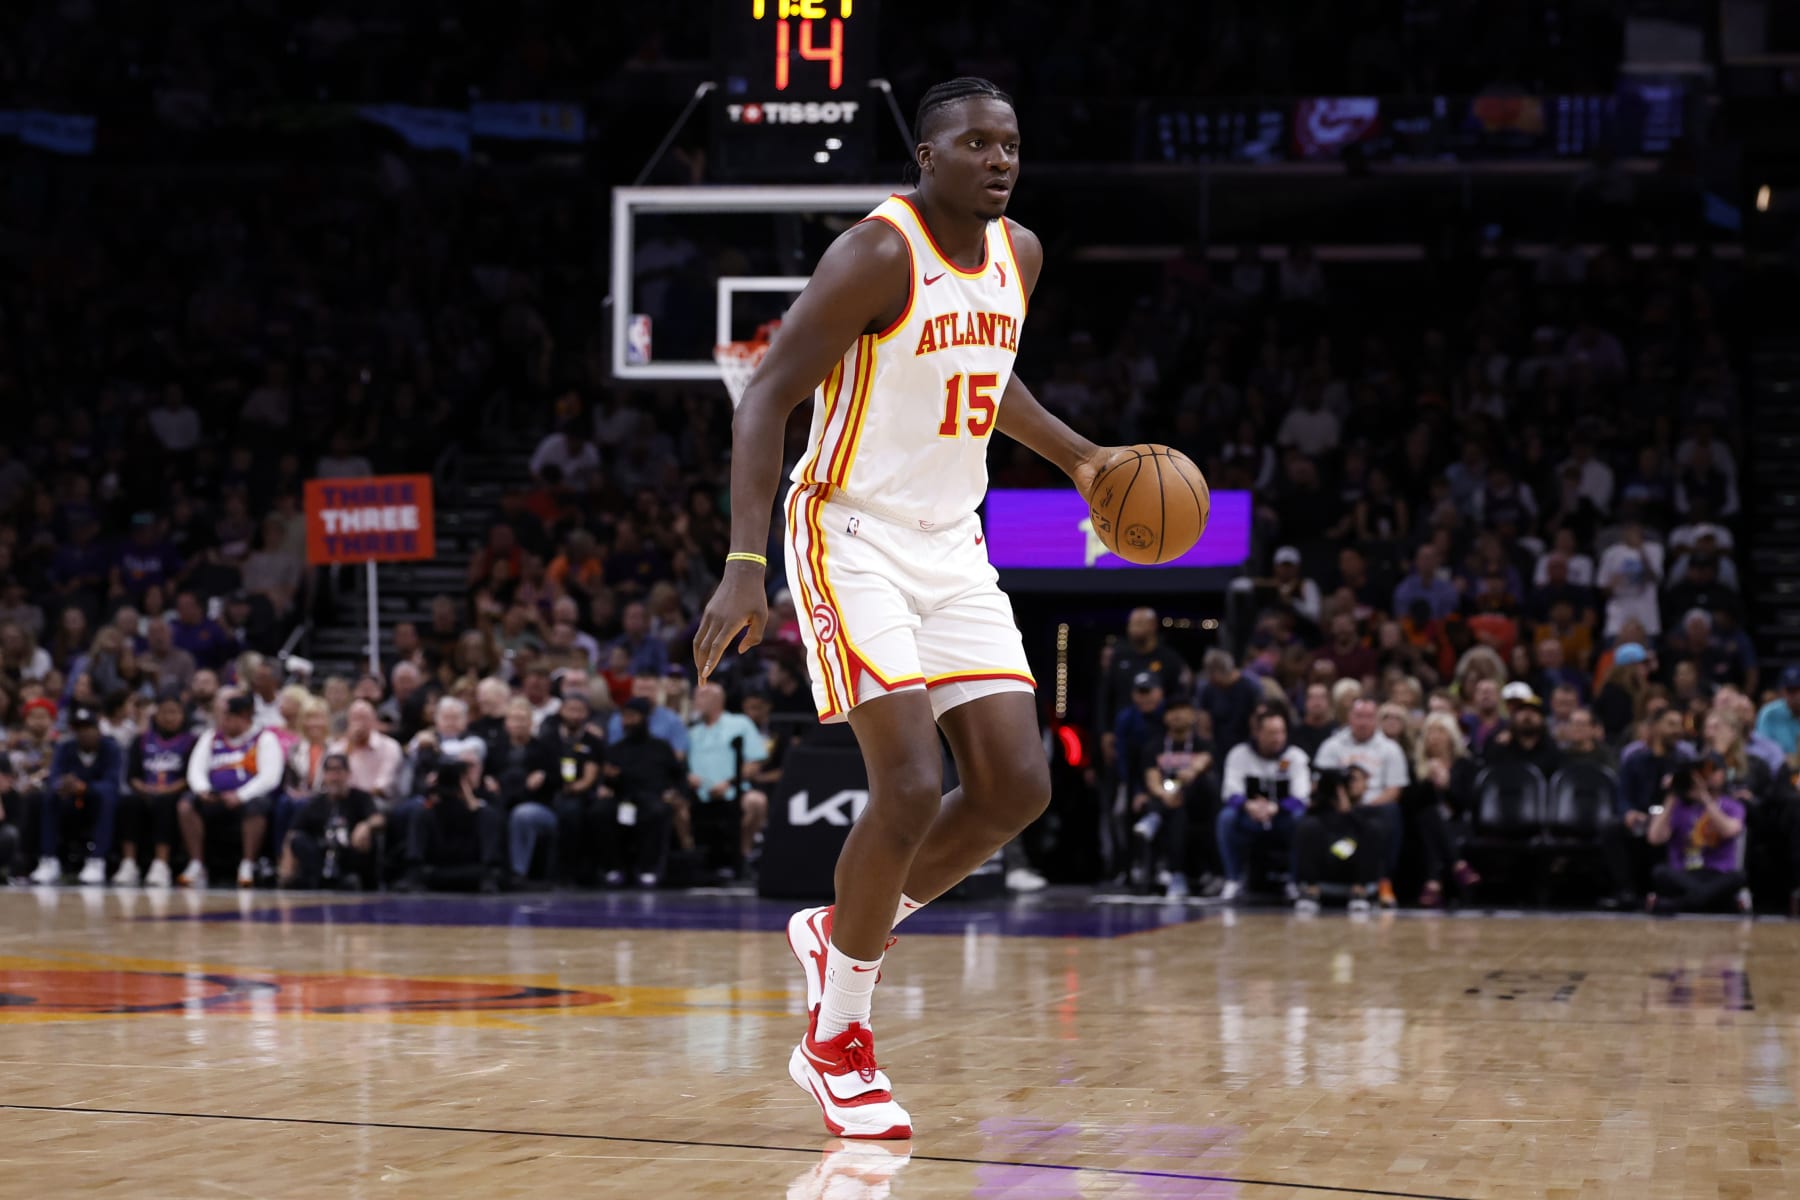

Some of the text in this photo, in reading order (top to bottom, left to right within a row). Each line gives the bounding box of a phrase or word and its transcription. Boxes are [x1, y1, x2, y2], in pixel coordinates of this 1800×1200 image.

[774, 17, 844, 91] 14
[763, 102, 858, 124] TISSOT
[915, 310, 1018, 357] ATLANTA
[938, 372, 999, 438] 15
[319, 504, 420, 535] THREE
[788, 789, 869, 826] KI
